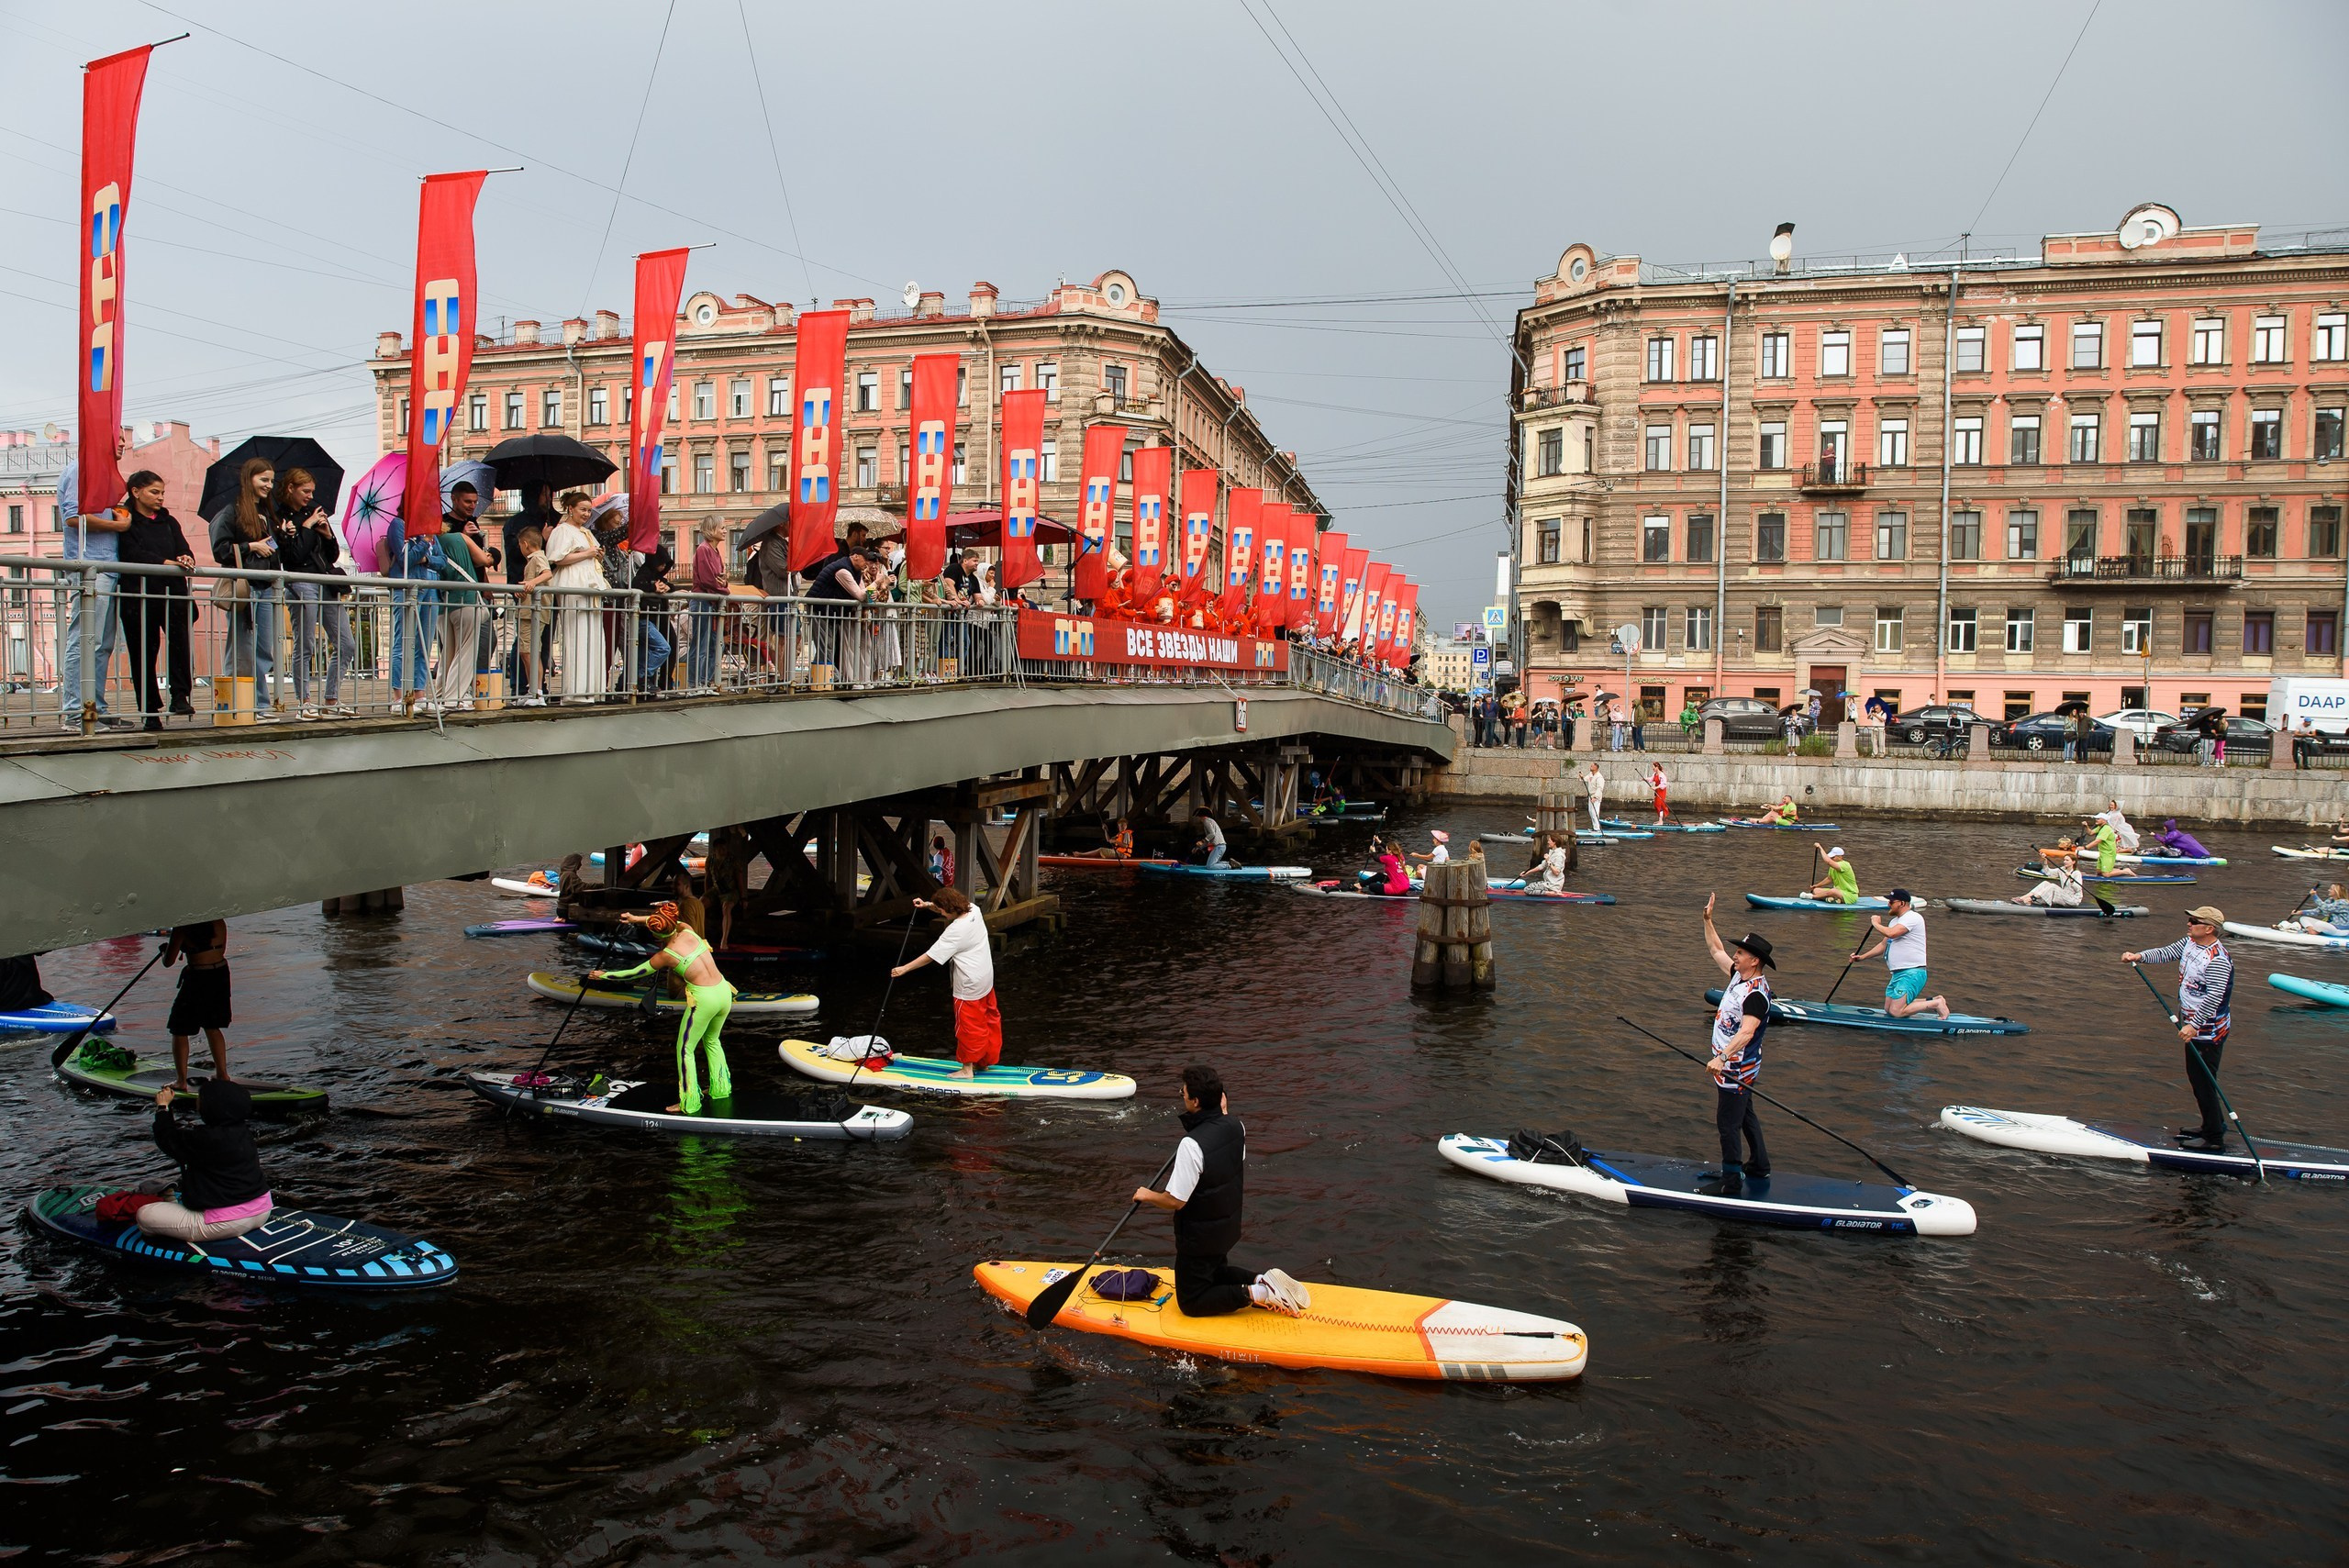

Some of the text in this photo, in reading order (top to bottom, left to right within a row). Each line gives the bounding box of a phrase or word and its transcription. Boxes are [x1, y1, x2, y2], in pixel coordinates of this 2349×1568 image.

[422, 278, 460, 446] ТНТ
[800, 386, 832, 504] ТНТ
[915, 419, 945, 520] ТНТ
[1008, 448, 1036, 538] ТНТ
[1082, 476, 1111, 554] ТНТ
[1139, 494, 1161, 566] ТНТ
[1186, 512, 1209, 577] ТНТ
[1230, 527, 1253, 586] ТНТ
[1264, 539, 1285, 595] ТНТ
[1290, 548, 1309, 600] ТНТ
[1319, 563, 1339, 613] ТНТ
[1054, 618, 1095, 657] ТНТ
[1379, 599, 1397, 640] ТНТ
[1395, 608, 1411, 648] ТНТ
[1126, 628, 1238, 664] ВСЕ ЗВЁЗДЫ НАШИ
[1255, 641, 1275, 668] ТНТ
[2299, 695, 2345, 709] DAAP
[2300, 1172, 2346, 1182] GLADIATOR
[1835, 1219, 1882, 1229] GLADIATOR
